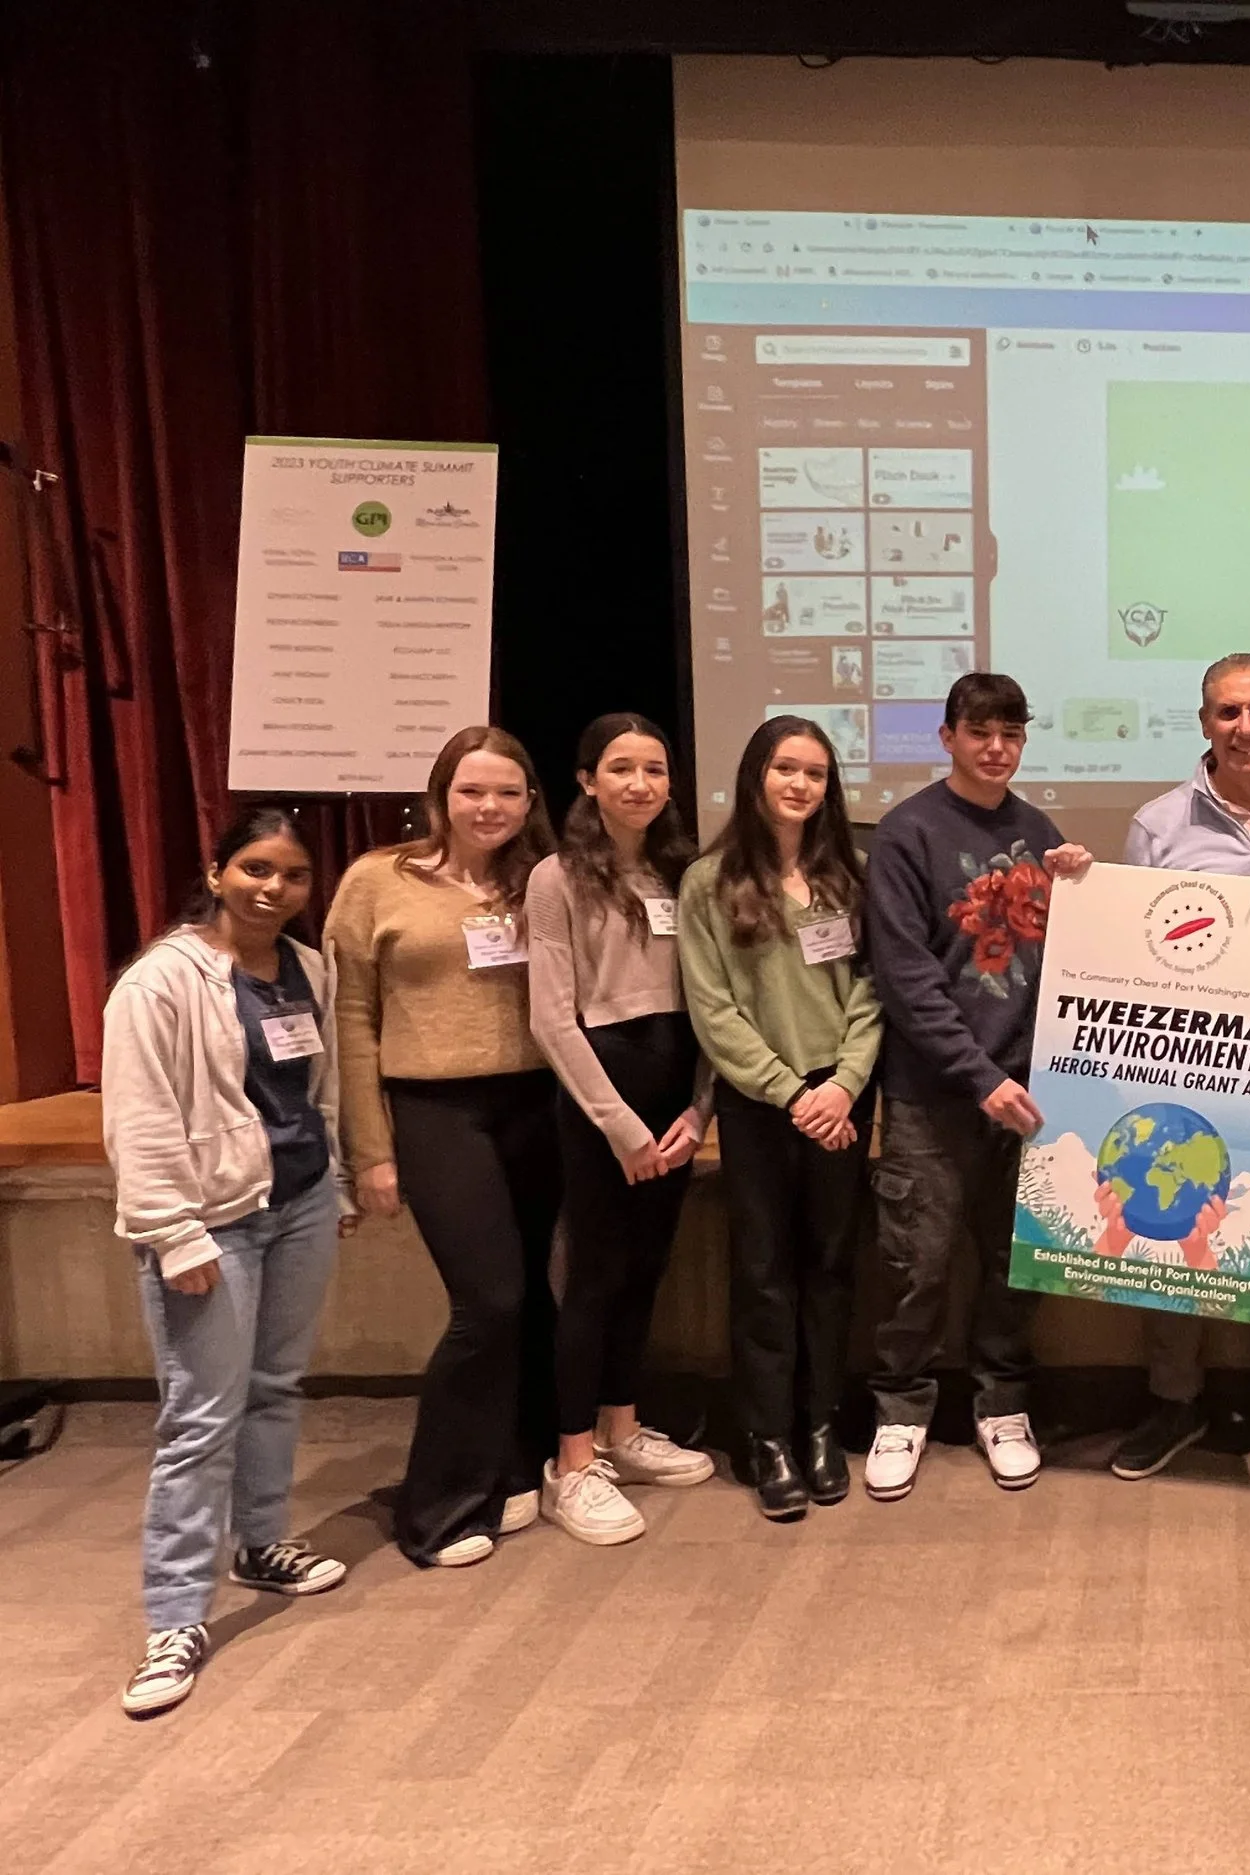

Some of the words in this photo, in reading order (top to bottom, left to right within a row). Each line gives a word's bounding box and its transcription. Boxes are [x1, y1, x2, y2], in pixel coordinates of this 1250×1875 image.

[309, 457, 356, 470] YOUTH
[359, 459, 418, 472] CLIMATE
[421, 461, 475, 473] SUMMIT
[329, 472, 416, 486] SUPPORTERS
[1061, 969, 1077, 980] The
[1080, 971, 1131, 987] Community
[1133, 977, 1159, 988] Chest
[1161, 980, 1172, 990] of
[1175, 981, 1194, 992] Port
[1049, 1055, 1110, 1079] HEROES
[1113, 1063, 1178, 1088] ANNUAL
[1183, 1072, 1240, 1095] GRANT
[1033, 1248, 1100, 1270] Established
[1104, 1259, 1117, 1272] to
[1120, 1261, 1163, 1279] Benefit
[1166, 1267, 1191, 1284] Port
[1064, 1266, 1147, 1290] Environmental
[1150, 1279, 1237, 1303] Organizations
